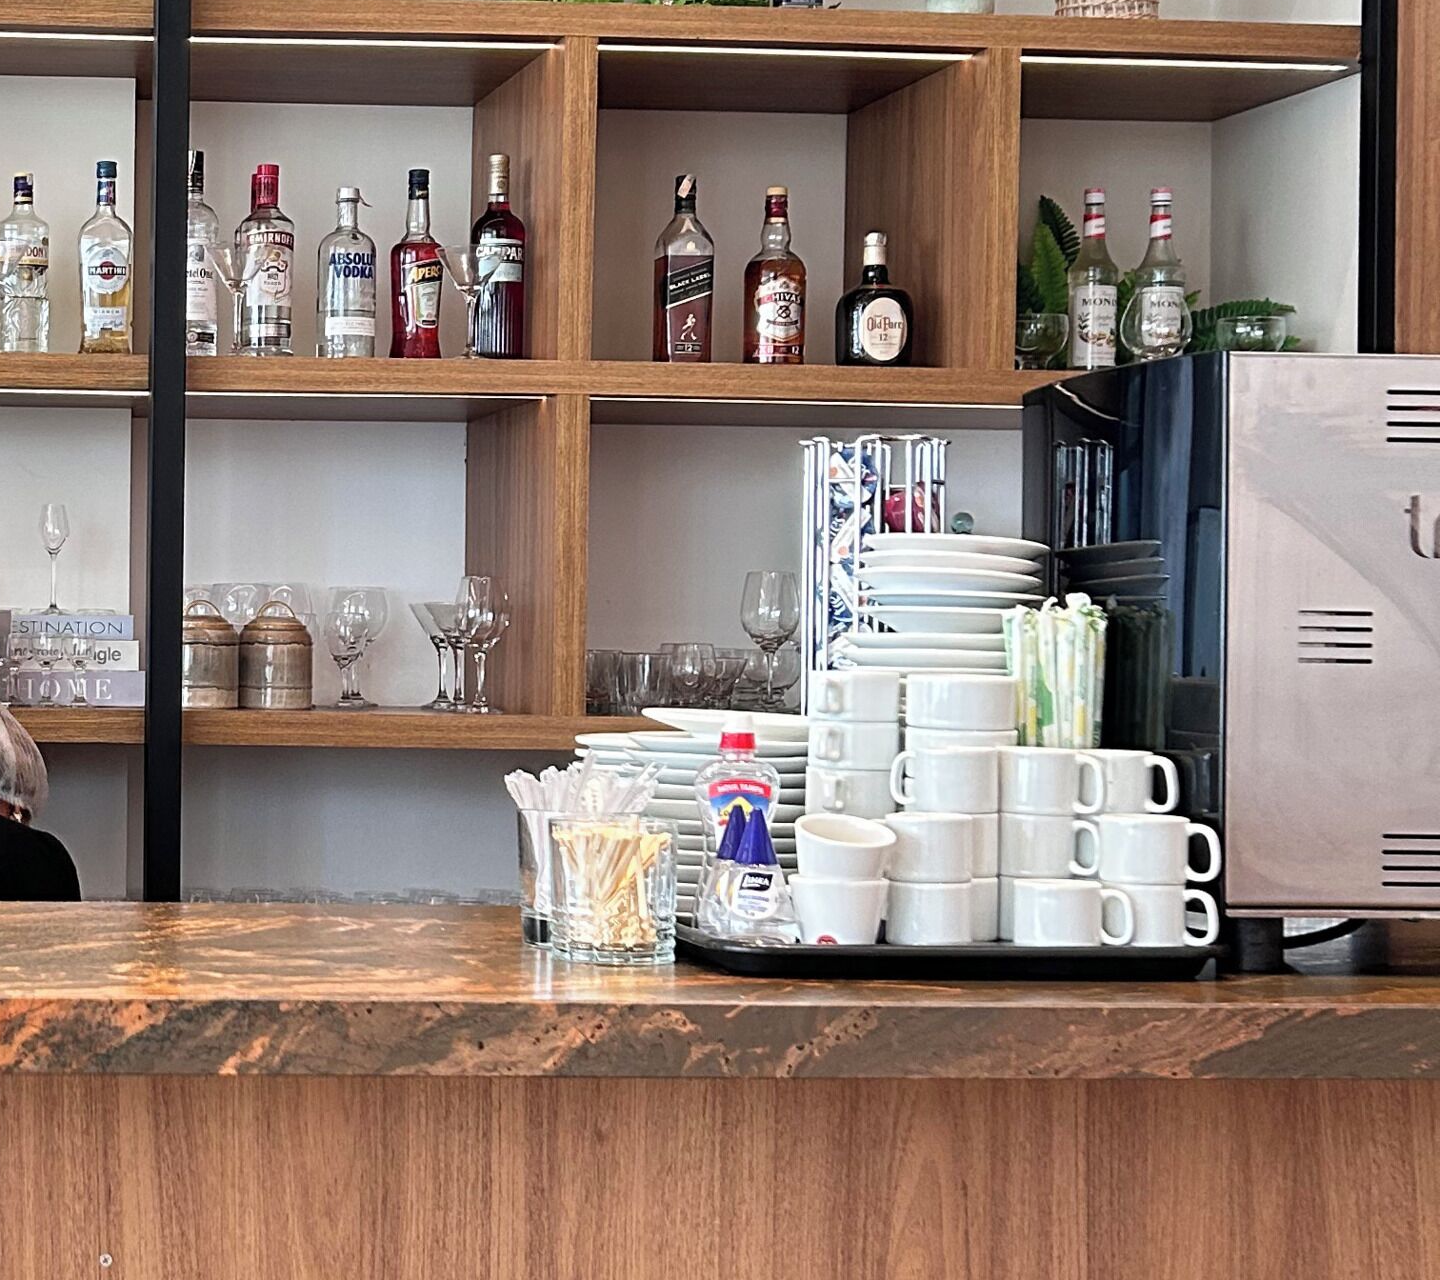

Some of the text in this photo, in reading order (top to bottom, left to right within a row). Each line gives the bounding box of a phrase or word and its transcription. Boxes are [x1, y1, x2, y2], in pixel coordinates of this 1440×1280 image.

[476, 246, 524, 260] CAMPAR
[89, 267, 126, 275] MARTINI
[334, 266, 374, 279] VODKA
[669, 277, 690, 290] BLACK
[691, 272, 712, 283] LABEL
[879, 333, 888, 341] 12
[685, 344, 693, 352] 12
[792, 346, 799, 354] 12
[12, 620, 123, 634] ESTINATION
[17, 678, 112, 700] HOME
